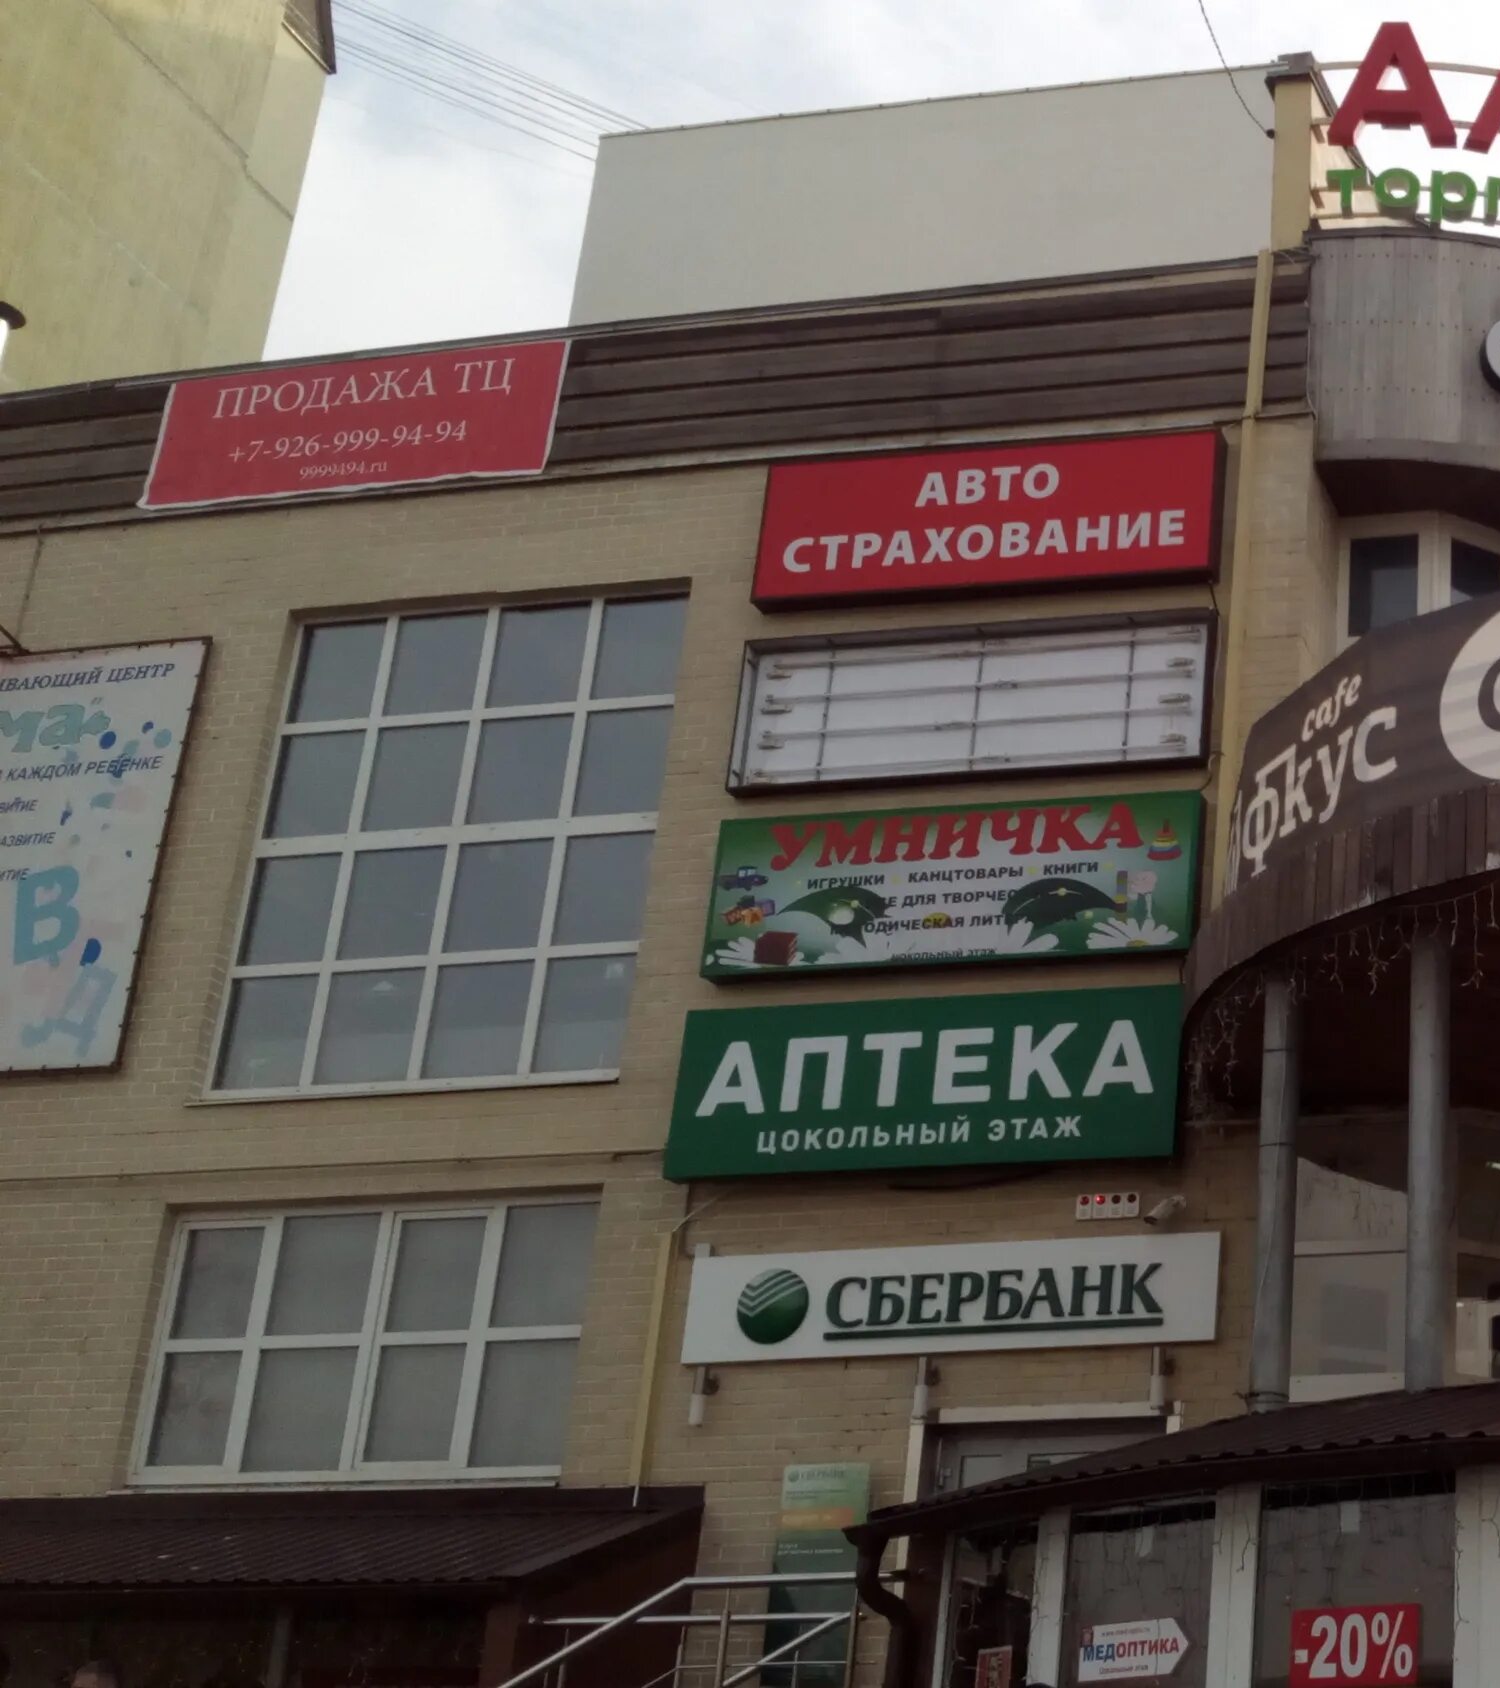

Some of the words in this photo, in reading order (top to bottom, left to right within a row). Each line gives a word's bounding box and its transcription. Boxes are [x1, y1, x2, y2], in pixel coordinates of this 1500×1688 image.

[213, 366, 436, 418] ПРОДАЖА
[455, 358, 514, 395] ТЦ
[228, 420, 467, 464] +7-926-999-94-94
[915, 463, 1059, 508] АВТО
[783, 509, 1186, 573] СТРАХОВАНИЕ
[107, 663, 176, 684] ЦЕНТР
[1301, 673, 1363, 741] cafe
[7, 762, 82, 783] КАЖДОМ
[770, 803, 1145, 871] УМНИЧКА
[807, 874, 885, 890] ИГРУШКИ
[908, 866, 1023, 884] КАНЦТОВАРЫ
[1043, 861, 1099, 875] КНИГИ
[902, 894, 936, 908] ДЛЯ
[695, 1019, 1154, 1117] АПТЕКА
[756, 1116, 971, 1154] ЦОКОЛЬНЫЙ
[987, 1115, 1082, 1142] ЭТАЖ
[823, 1262, 1163, 1329] СБЕРБАНК
[1082, 1638, 1179, 1662] МЕДОПТИКА
[1292, 1610, 1413, 1679] -20%
